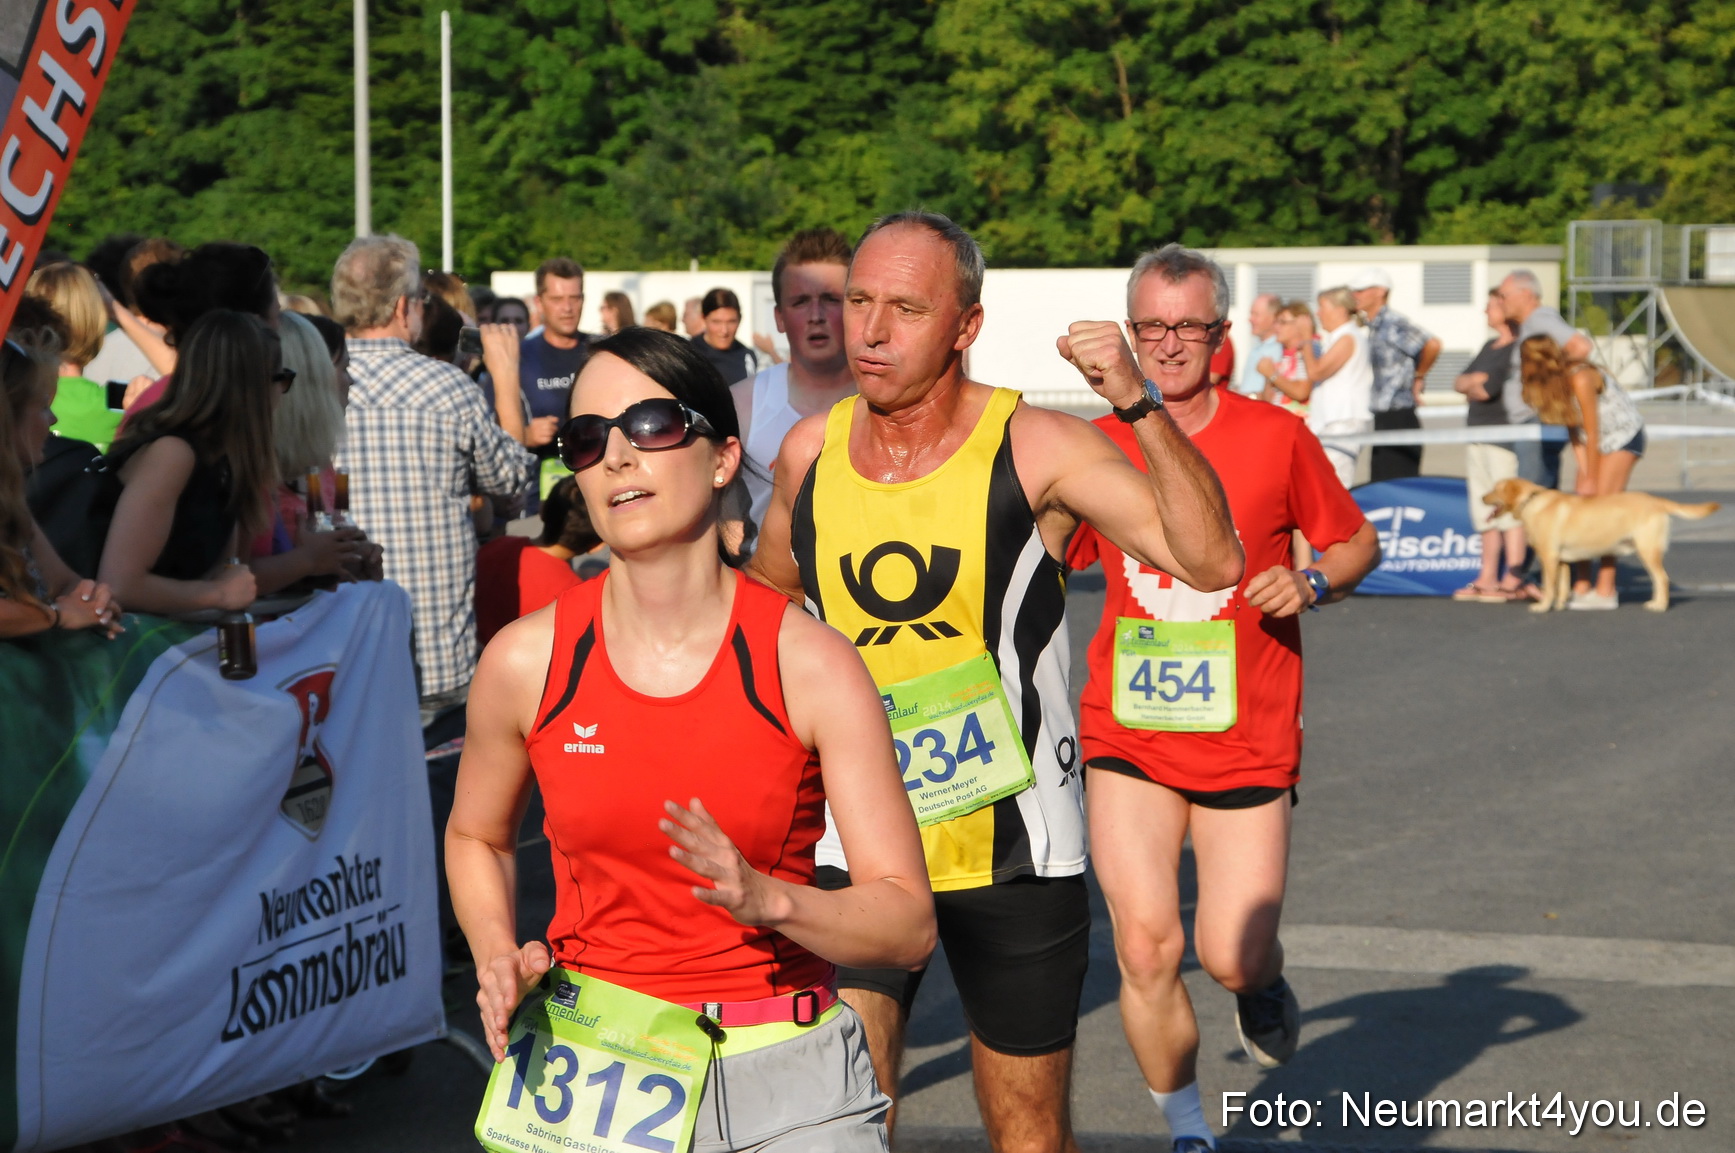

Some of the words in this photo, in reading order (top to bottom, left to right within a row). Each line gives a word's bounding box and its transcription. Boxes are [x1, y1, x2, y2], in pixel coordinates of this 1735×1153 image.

[1378, 527, 1482, 558] Fische
[1381, 557, 1482, 572] AUTOMOBIL
[1129, 659, 1215, 702] 454
[888, 702, 918, 720] enlauf
[564, 741, 605, 754] erima
[893, 711, 996, 792] 234
[918, 799, 955, 814] Deutsche
[956, 790, 974, 803] Post
[975, 784, 988, 795] AG
[919, 786, 951, 801] Werner
[952, 776, 978, 791] Meyer
[258, 854, 382, 945] Neumarkter
[220, 910, 406, 1043] Lammsbräu
[504, 1033, 686, 1153] 1312
[486, 1127, 530, 1151] Sparkasse
[526, 1123, 562, 1145] Sabrina
